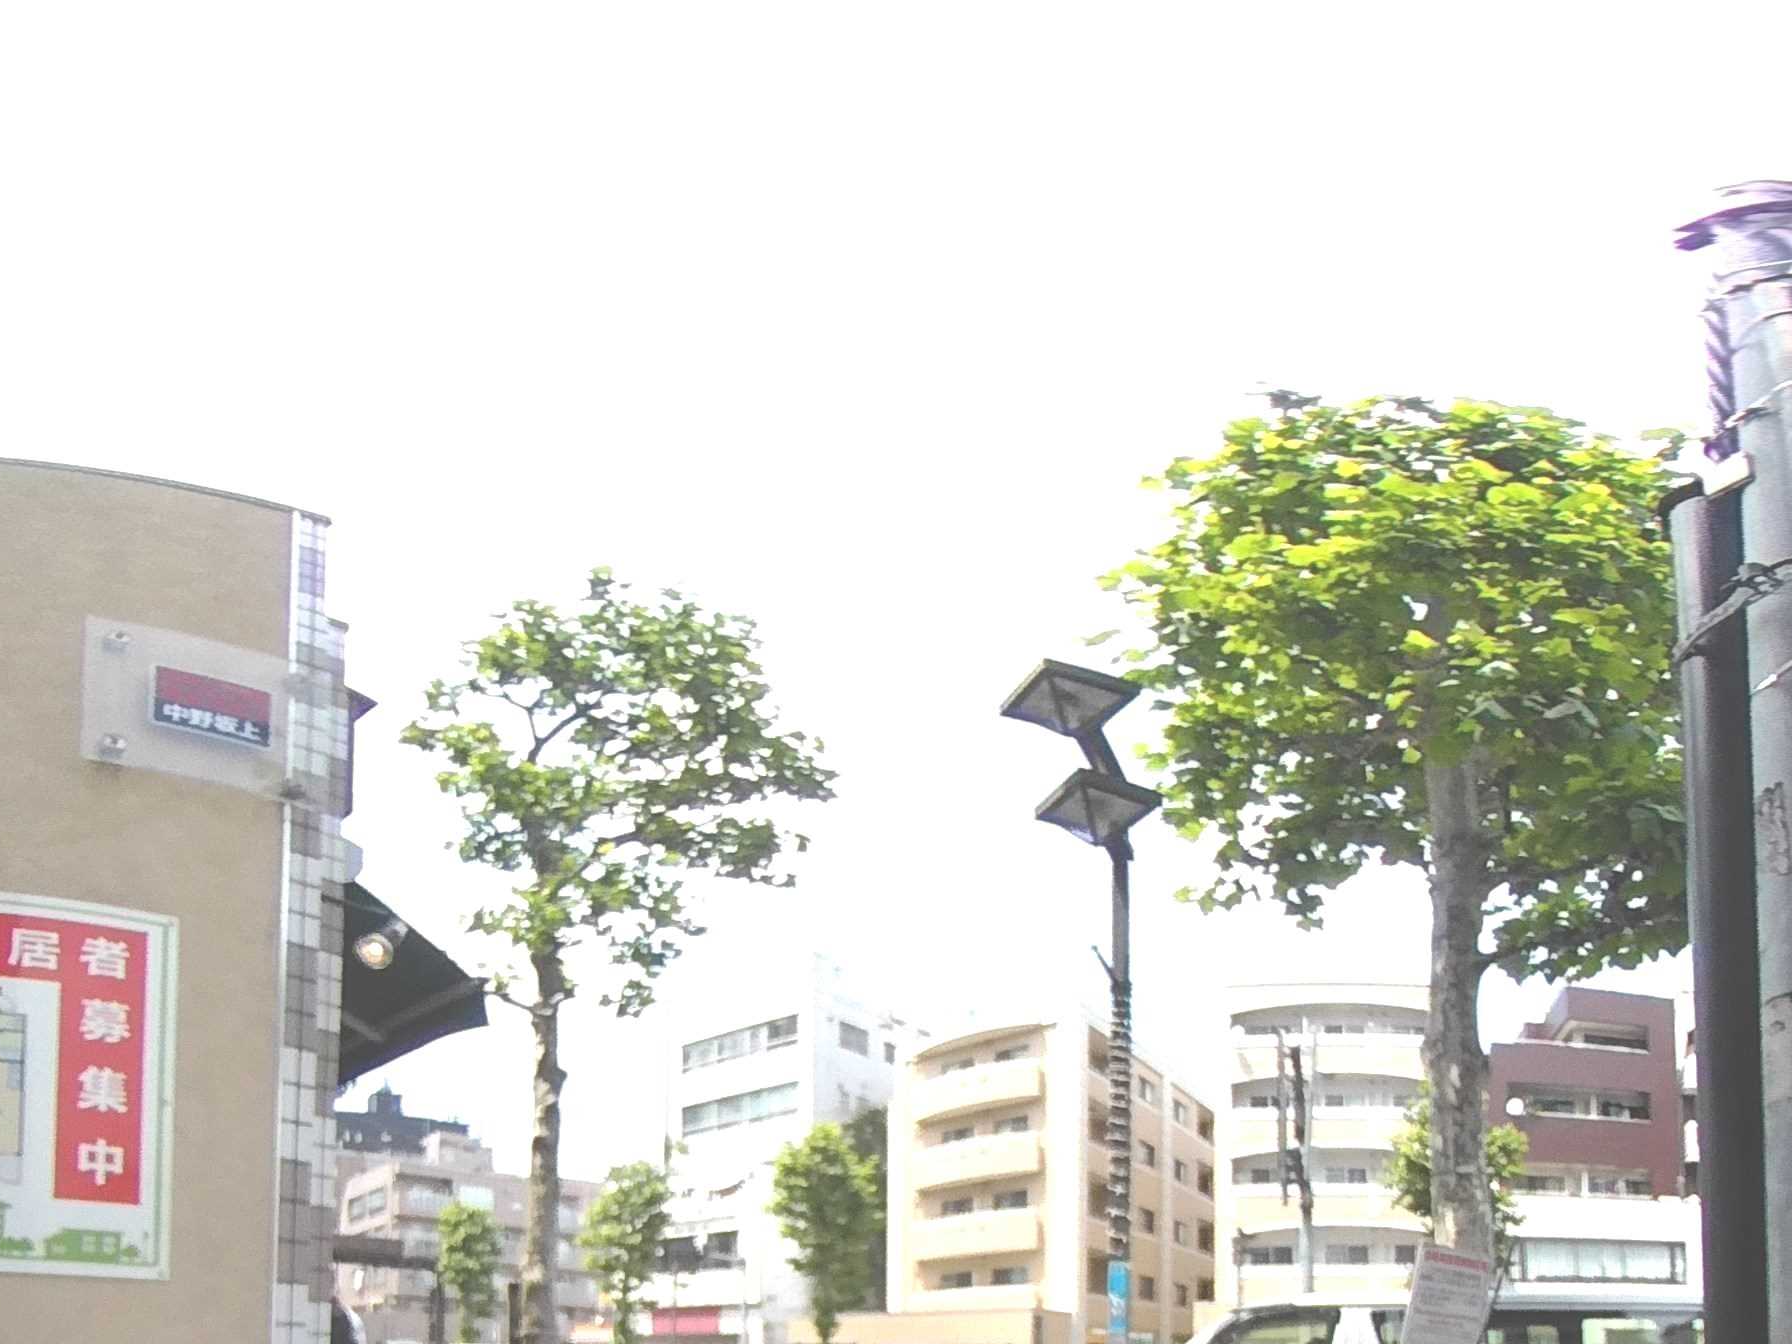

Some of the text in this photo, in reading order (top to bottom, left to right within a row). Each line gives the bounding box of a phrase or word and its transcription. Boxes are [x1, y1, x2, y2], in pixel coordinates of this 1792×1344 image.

[163, 704, 261, 740] 中野坂上
[77, 998, 131, 1186] 募集中
